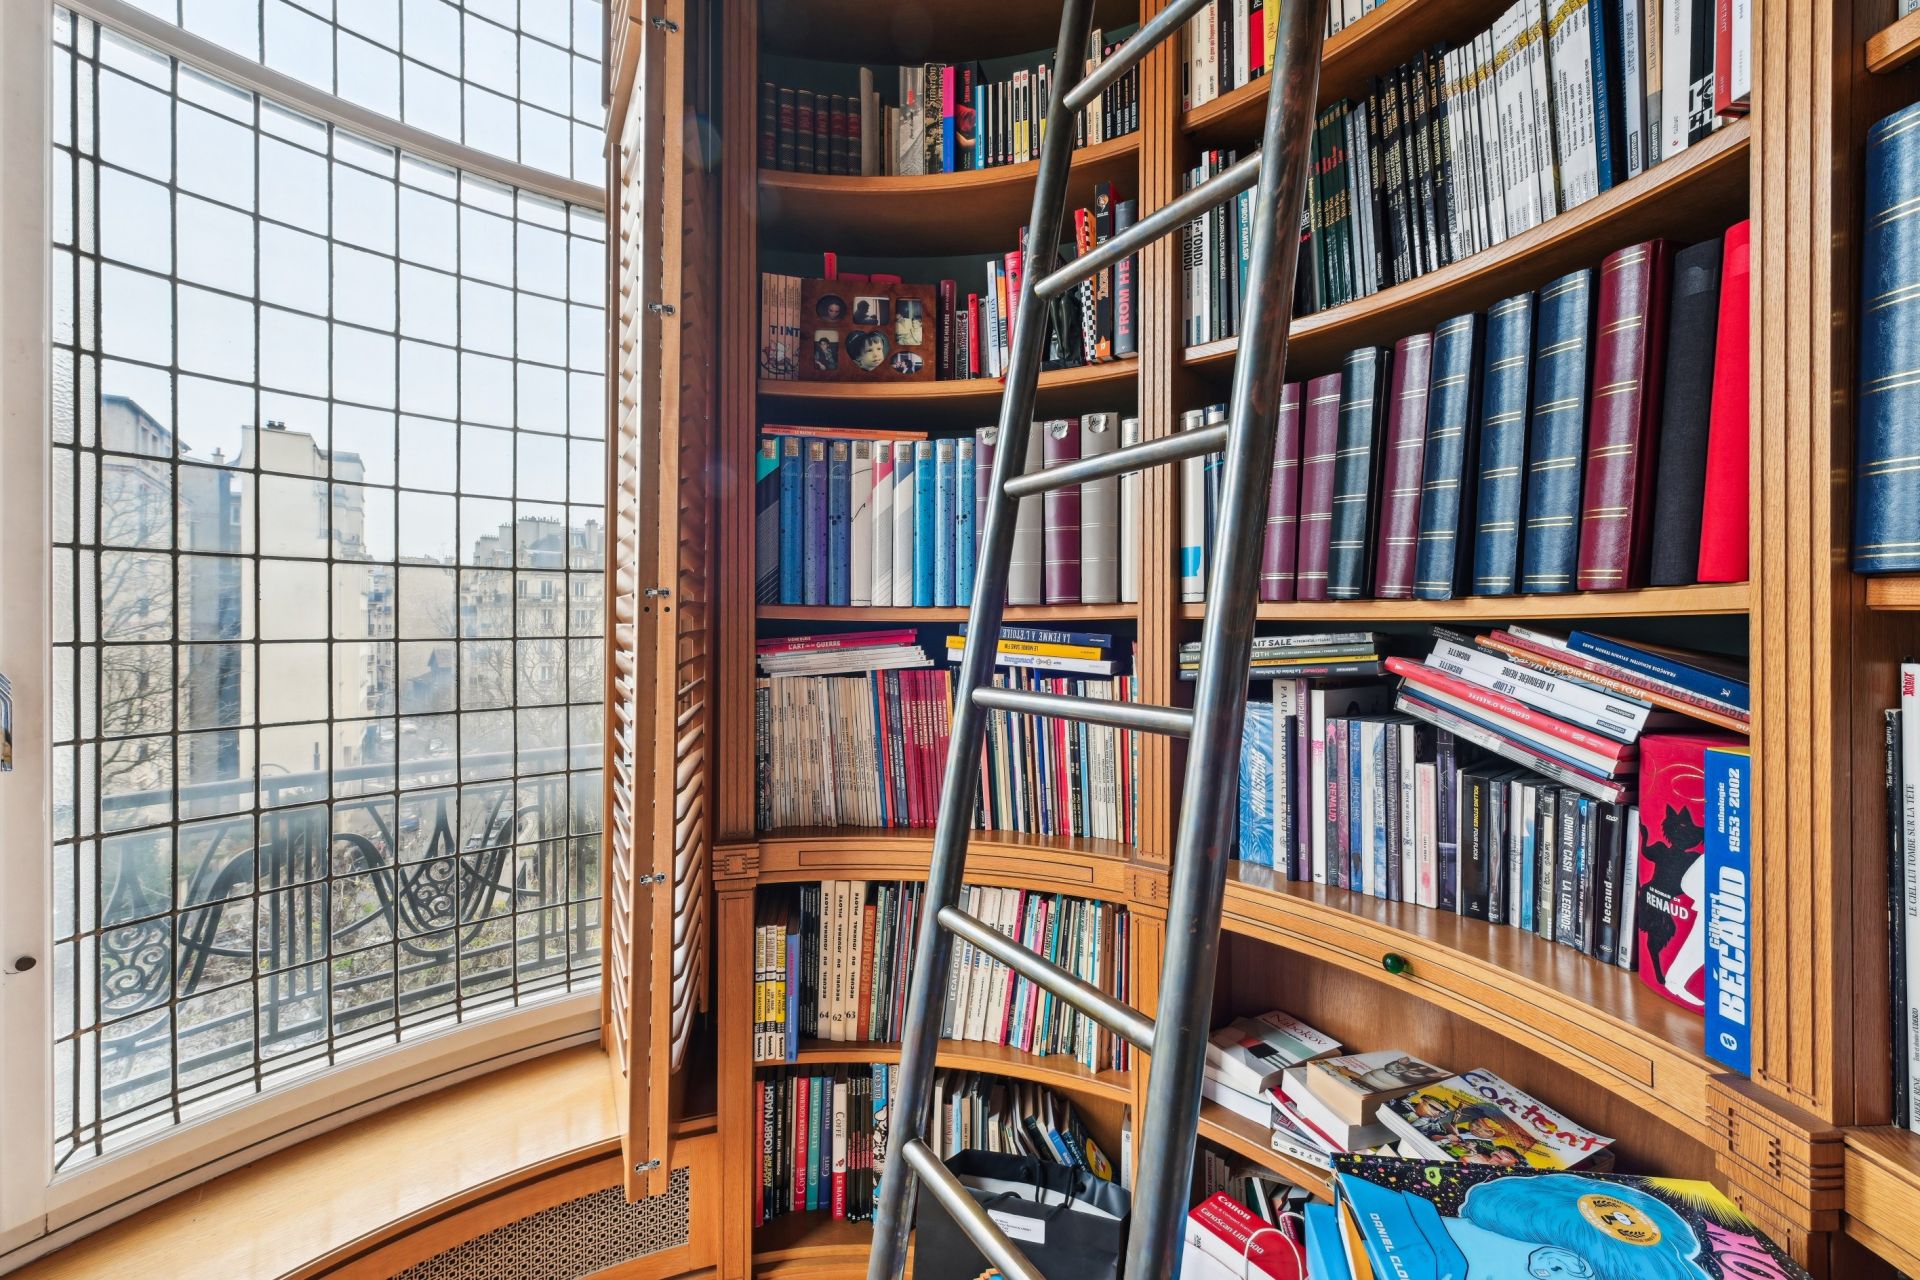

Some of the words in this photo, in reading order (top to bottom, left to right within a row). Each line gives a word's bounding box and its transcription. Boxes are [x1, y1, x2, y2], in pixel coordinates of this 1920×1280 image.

[927, 66, 937, 106] Simenon
[1598, 99, 1605, 109] DU
[1599, 110, 1608, 147] PASSAGERS
[1630, 132, 1639, 169] casterman
[1651, 123, 1659, 160] casterman
[1240, 198, 1248, 224] SPIROU
[1193, 233, 1203, 267] TONDU
[1241, 227, 1249, 261] FANTASIO
[1118, 289, 1130, 336] FROM
[816, 640, 841, 648] GUERRE
[1002, 628, 1031, 641] L'ÉTOILE
[1039, 631, 1061, 642] FEMME
[1061, 634, 1071, 643] LA
[1268, 638, 1292, 647] SALE
[1447, 647, 1472, 662] ROCHETTE
[1438, 661, 1464, 675] ROCHETTE
[1501, 666, 1518, 681] REINE
[1546, 659, 1582, 679] L'ESPOIR
[1618, 682, 1647, 698] TOUT
[1492, 680, 1508, 692] LOUP
[1507, 685, 1516, 695] LE
[1518, 671, 1546, 691] DERNIÈRE
[1546, 683, 1556, 693] LA
[1605, 668, 1647, 689] DERNIER
[1649, 680, 1687, 702] VOYAGE
[1688, 694, 1702, 707] DE
[1467, 692, 1499, 709] O'KEEFFE
[1498, 703, 1531, 720] GEORGIA
[1250, 747, 1267, 818] GAINSBOURG
[1729, 768, 1741, 807] 2002
[1904, 783, 1915, 805] TÊTE
[1329, 782, 1337, 822] RENAUD
[1717, 782, 1725, 834] Anthologie
[1906, 806, 1915, 818] LA
[1563, 813, 1573, 847] JOHNNY
[1729, 818, 1741, 852] 1953
[1906, 819, 1916, 837] SUR
[1562, 849, 1573, 872] CASH
[1906, 838, 1916, 867] TOMBE
[1562, 880, 1572, 892] LA
[1906, 868, 1916, 883] LUI
[1602, 880, 1613, 923] becaud
[1907, 885, 1917, 904] CIEL
[1560, 893, 1571, 931] LEGENDE
[1645, 892, 1689, 921] RENAUD
[1908, 905, 1918, 917] LE
[864, 909, 873, 940] PAPIER
[1709, 894, 1722, 950] Gilbert
[863, 941, 872, 952] DE
[1714, 866, 1746, 1026] BÉCAUD
[952, 957, 960, 968] DE
[862, 982, 869, 995] UN
[950, 969, 959, 991] CAFE
[950, 991, 956, 1001] LE
[819, 1010, 830, 1019] 64
[832, 1014, 842, 1022] 62
[846, 1010, 856, 1019] 63
[1270, 1011, 1328, 1047] Nabokov
[812, 1080, 820, 1106] PLAISIR
[874, 1068, 882, 1100] BICOT
[764, 1086, 774, 1118] NAISH
[764, 1118, 774, 1154] ROBBY
[833, 1111, 844, 1139] COFFE
[809, 1163, 818, 1186] COFFE
[821, 1155, 831, 1177] COFFE
[795, 1167, 806, 1194] COFFE
[836, 1175, 843, 1184] LE
[1217, 1195, 1252, 1221] Canon
[1200, 1207, 1233, 1234] CanoScan
[1369, 1212, 1392, 1253] DANIEL
